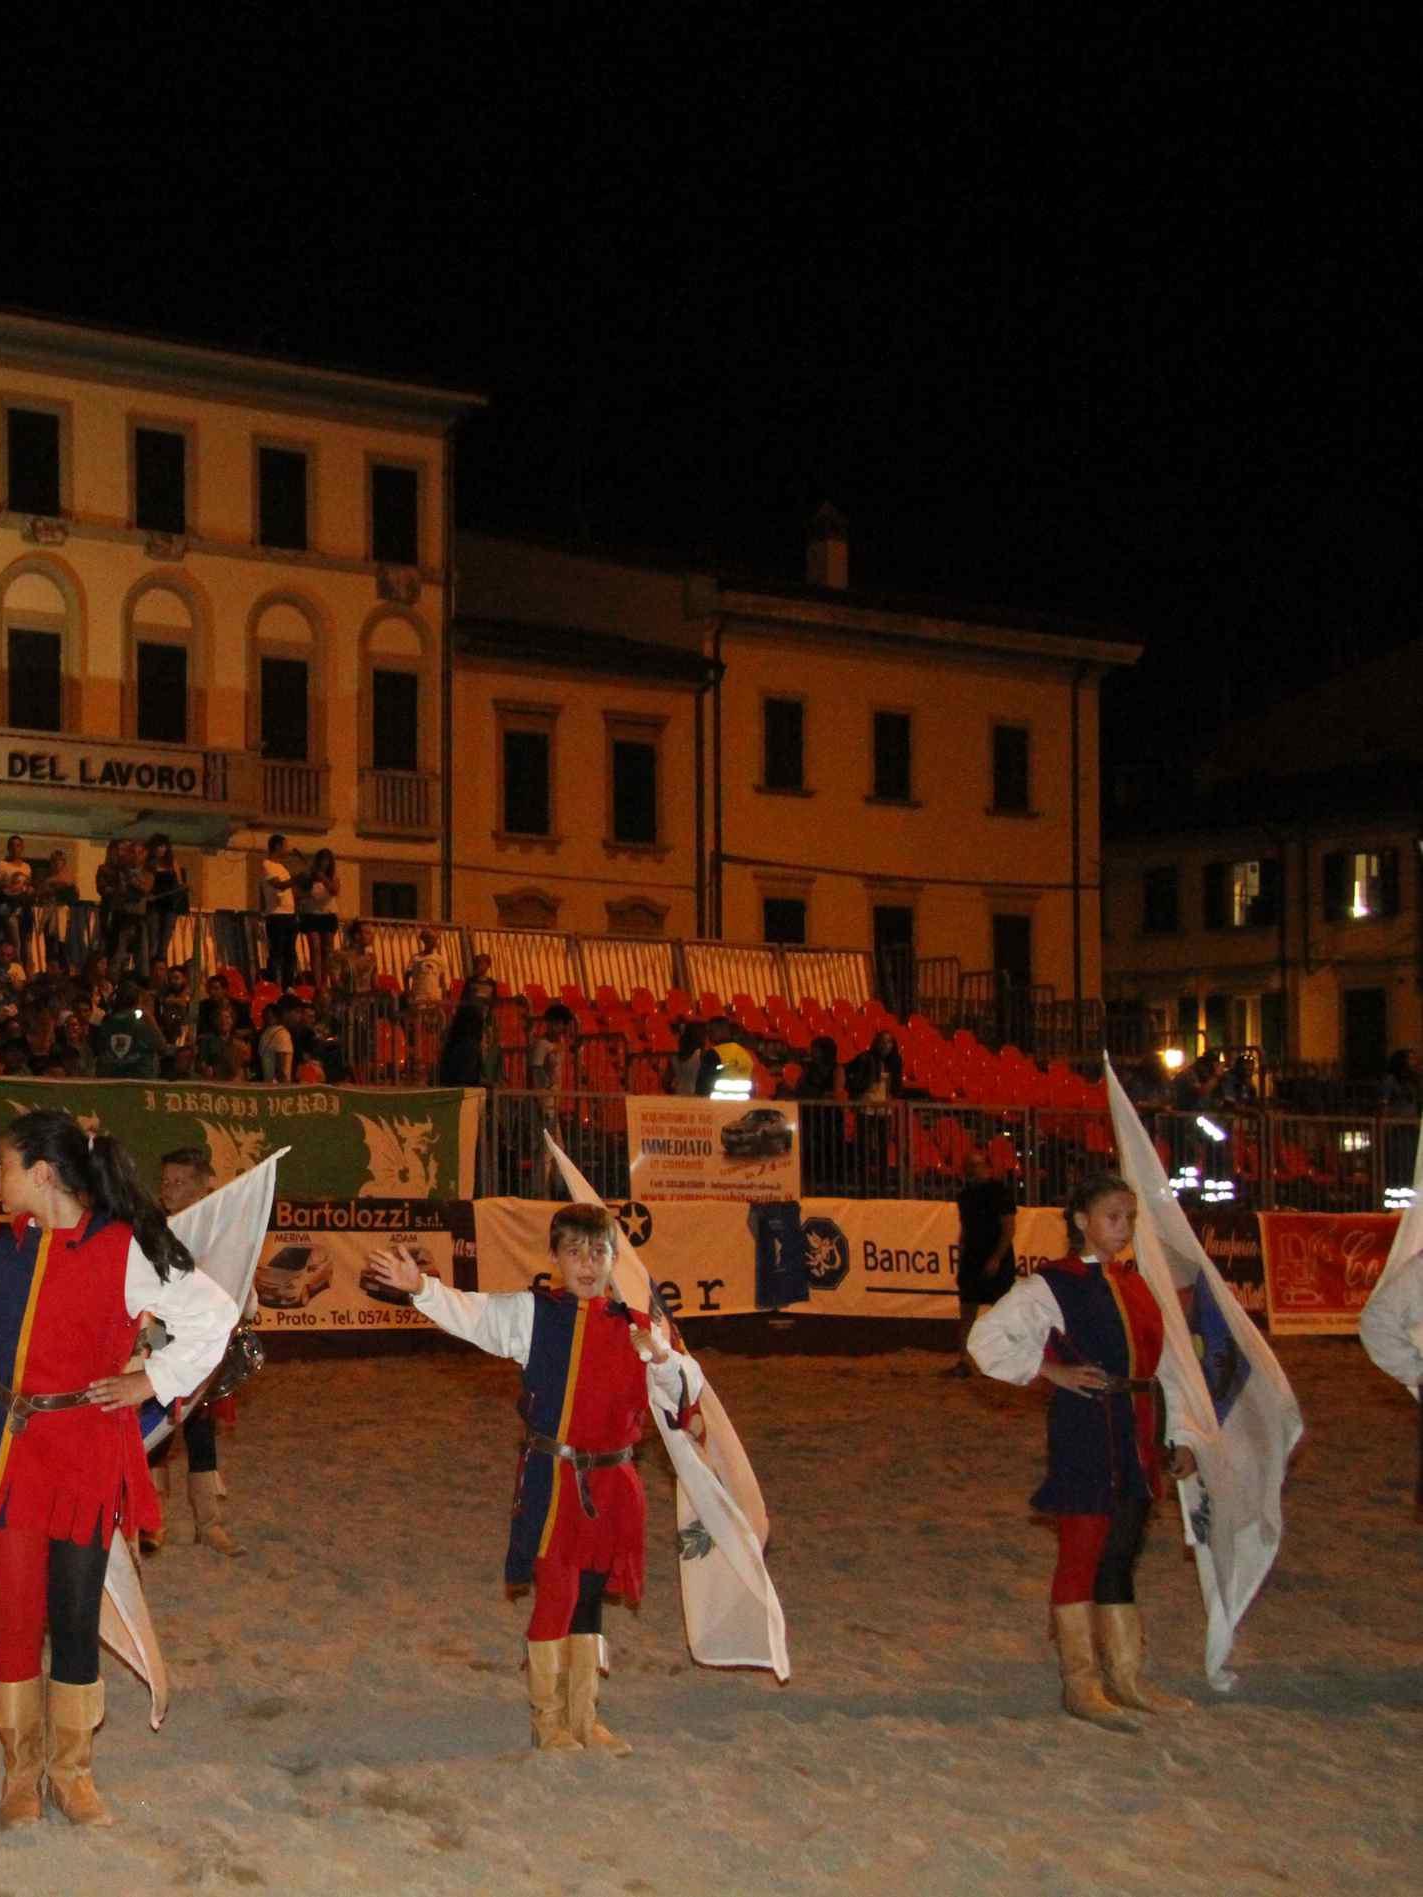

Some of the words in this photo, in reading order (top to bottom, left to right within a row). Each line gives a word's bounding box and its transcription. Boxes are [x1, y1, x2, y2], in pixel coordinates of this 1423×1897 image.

[7, 751, 67, 783] DEL
[79, 757, 197, 793] LAVORO
[165, 1092, 259, 1117] DRAGHI
[268, 1092, 341, 1118] VERDI
[641, 1139, 713, 1156] IMMEDIATO
[275, 1200, 410, 1228] Bartolozzi
[414, 1209, 445, 1228] s.r.l.
[273, 1233, 313, 1243] MERIVA
[389, 1232, 418, 1243] ADAM
[863, 1240, 940, 1275] Banca
[276, 1311, 316, 1326] Prato
[330, 1311, 353, 1326] Tel.
[358, 1310, 390, 1325] 0574
